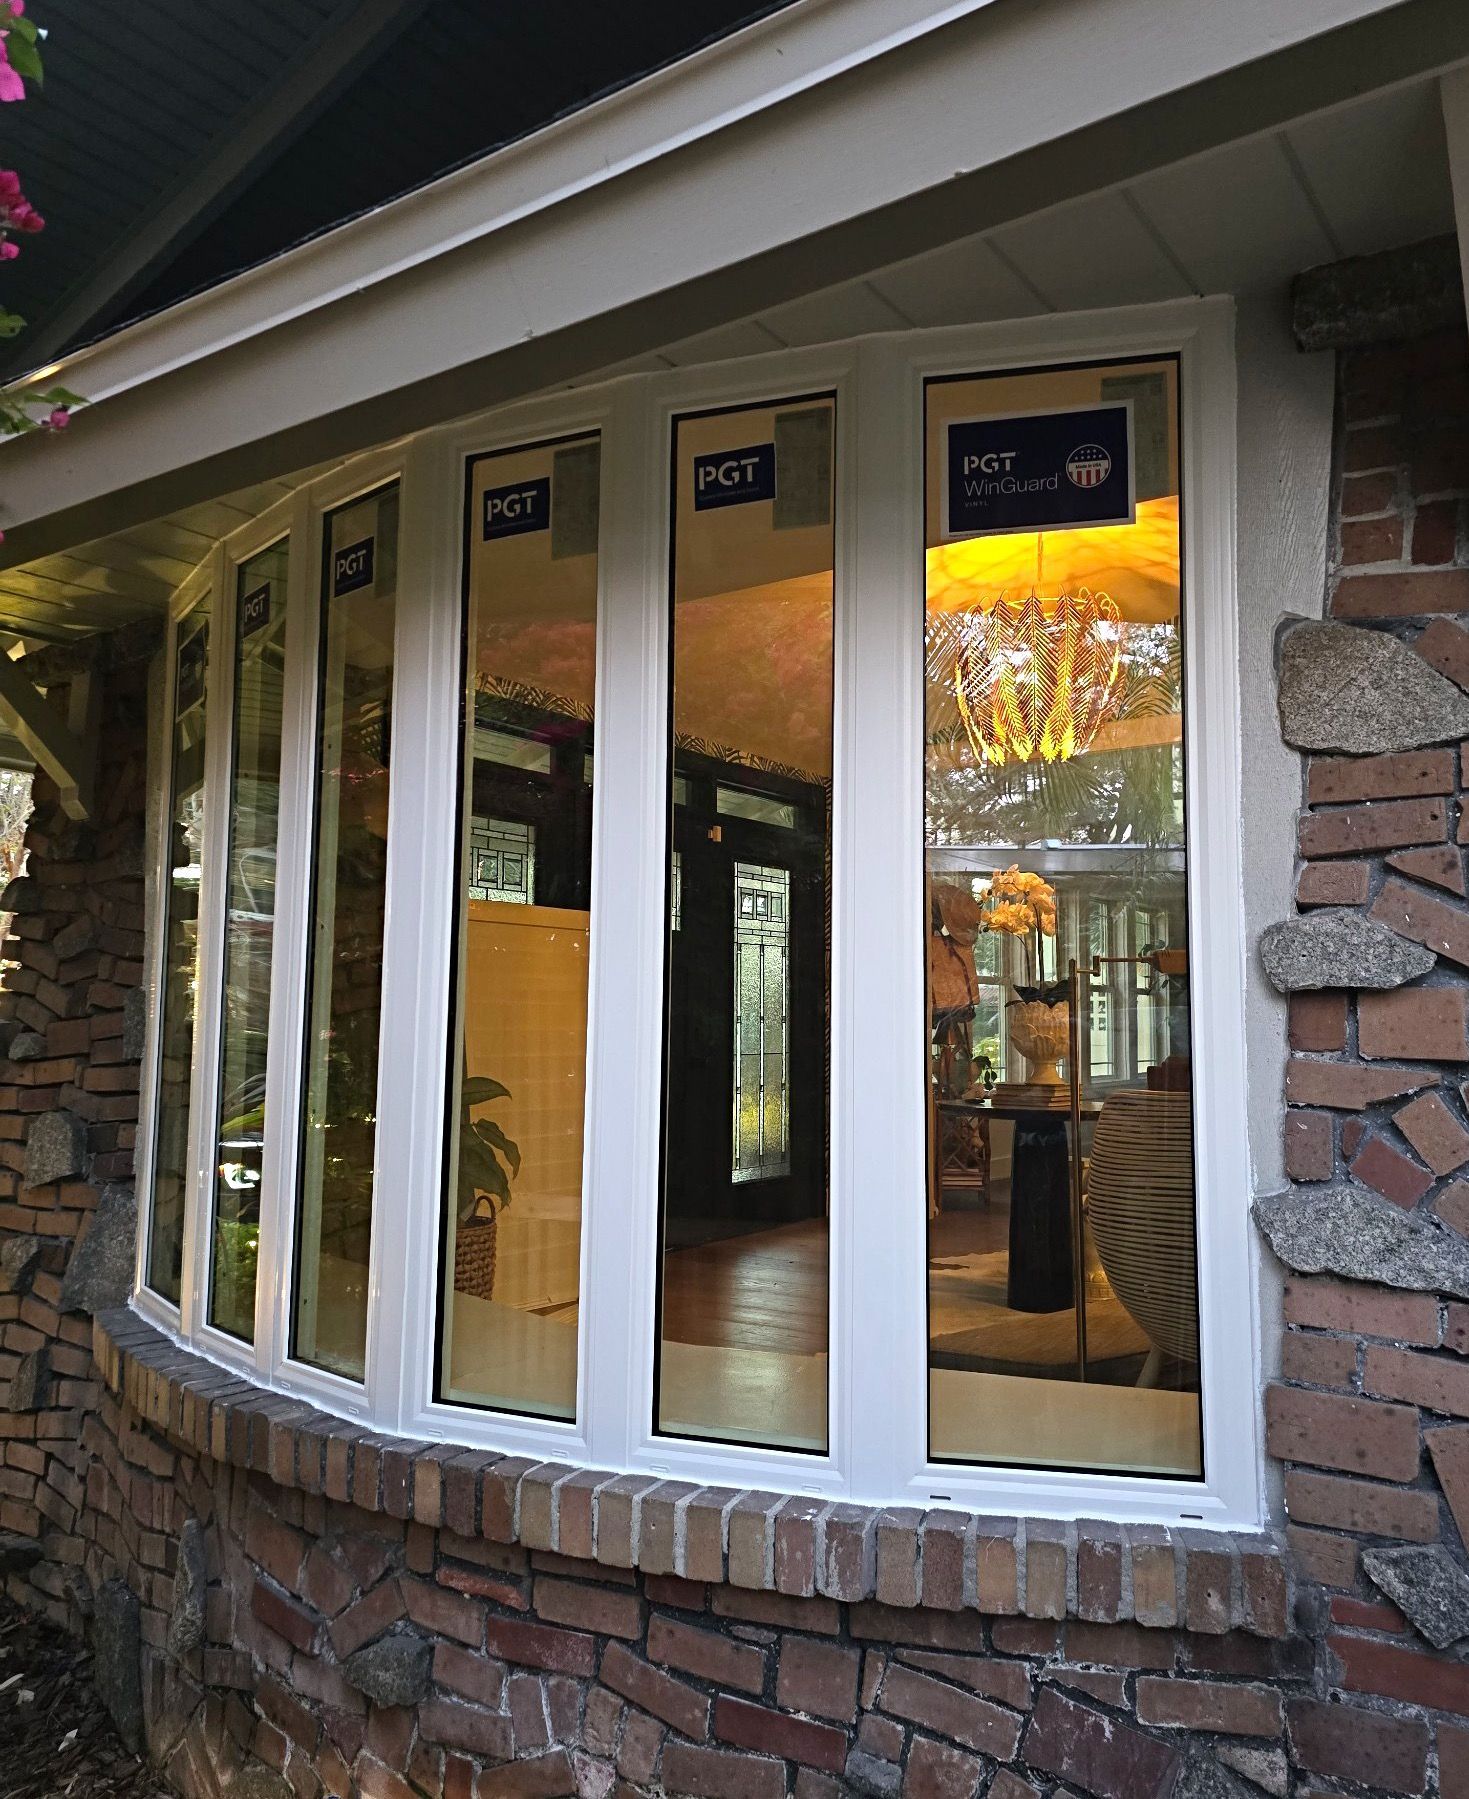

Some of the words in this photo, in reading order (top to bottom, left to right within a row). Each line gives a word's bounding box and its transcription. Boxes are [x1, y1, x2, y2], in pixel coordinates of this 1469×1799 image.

[698, 457, 760, 490] PGT
[964, 452, 1016, 475] PGT
[964, 472, 1058, 497] WinGuard
[487, 490, 538, 522] PGT
[965, 500, 989, 508] VINYL
[336, 549, 367, 580] PGT
[244, 594, 266, 623] PGT
